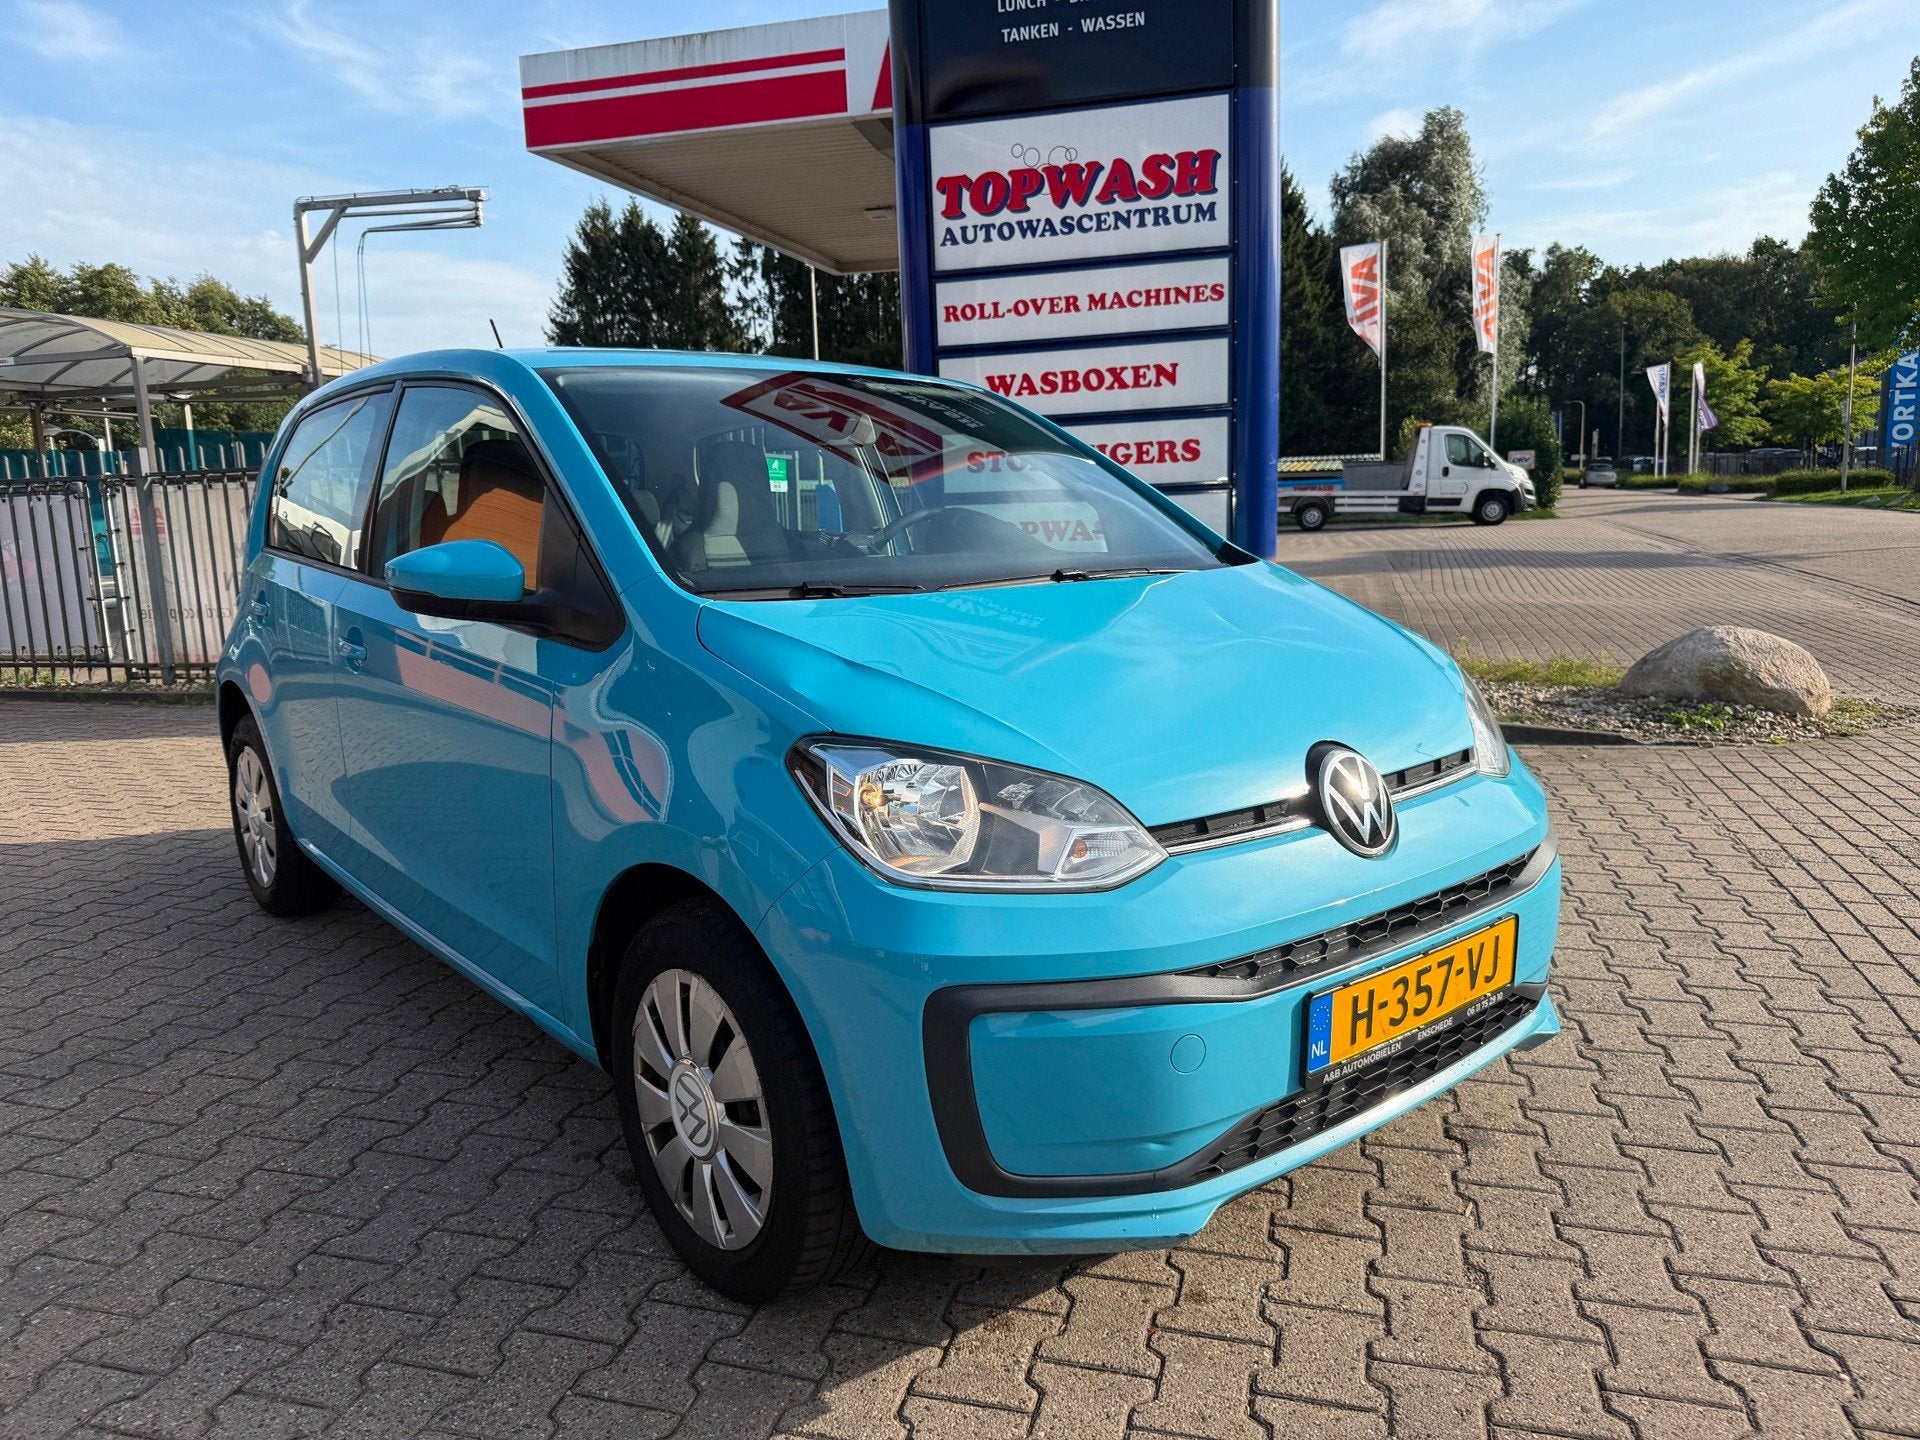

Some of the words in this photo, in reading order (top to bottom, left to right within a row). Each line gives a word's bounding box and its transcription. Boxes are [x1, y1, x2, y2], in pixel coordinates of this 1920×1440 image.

[1002, 22, 1059, 43] TANKEN
[1081, 11, 1145, 33] WASSEN
[936, 149, 1222, 219] TOPWASH
[940, 201, 1218, 246] AUTOWASCENTRUM
[943, 295, 1081, 324] ROLL-OVER
[1087, 283, 1225, 312] MACHINES
[985, 362, 1179, 398] WASBOXEN
[1350, 935, 1500, 1047] H-357-VJ
[1311, 1039, 1327, 1059] NL
[1323, 1069, 1341, 1084] A&B
[1342, 1041, 1402, 1075] AUTOMOBIELEN
[1417, 1016, 1453, 1041] ENSCHEDE
